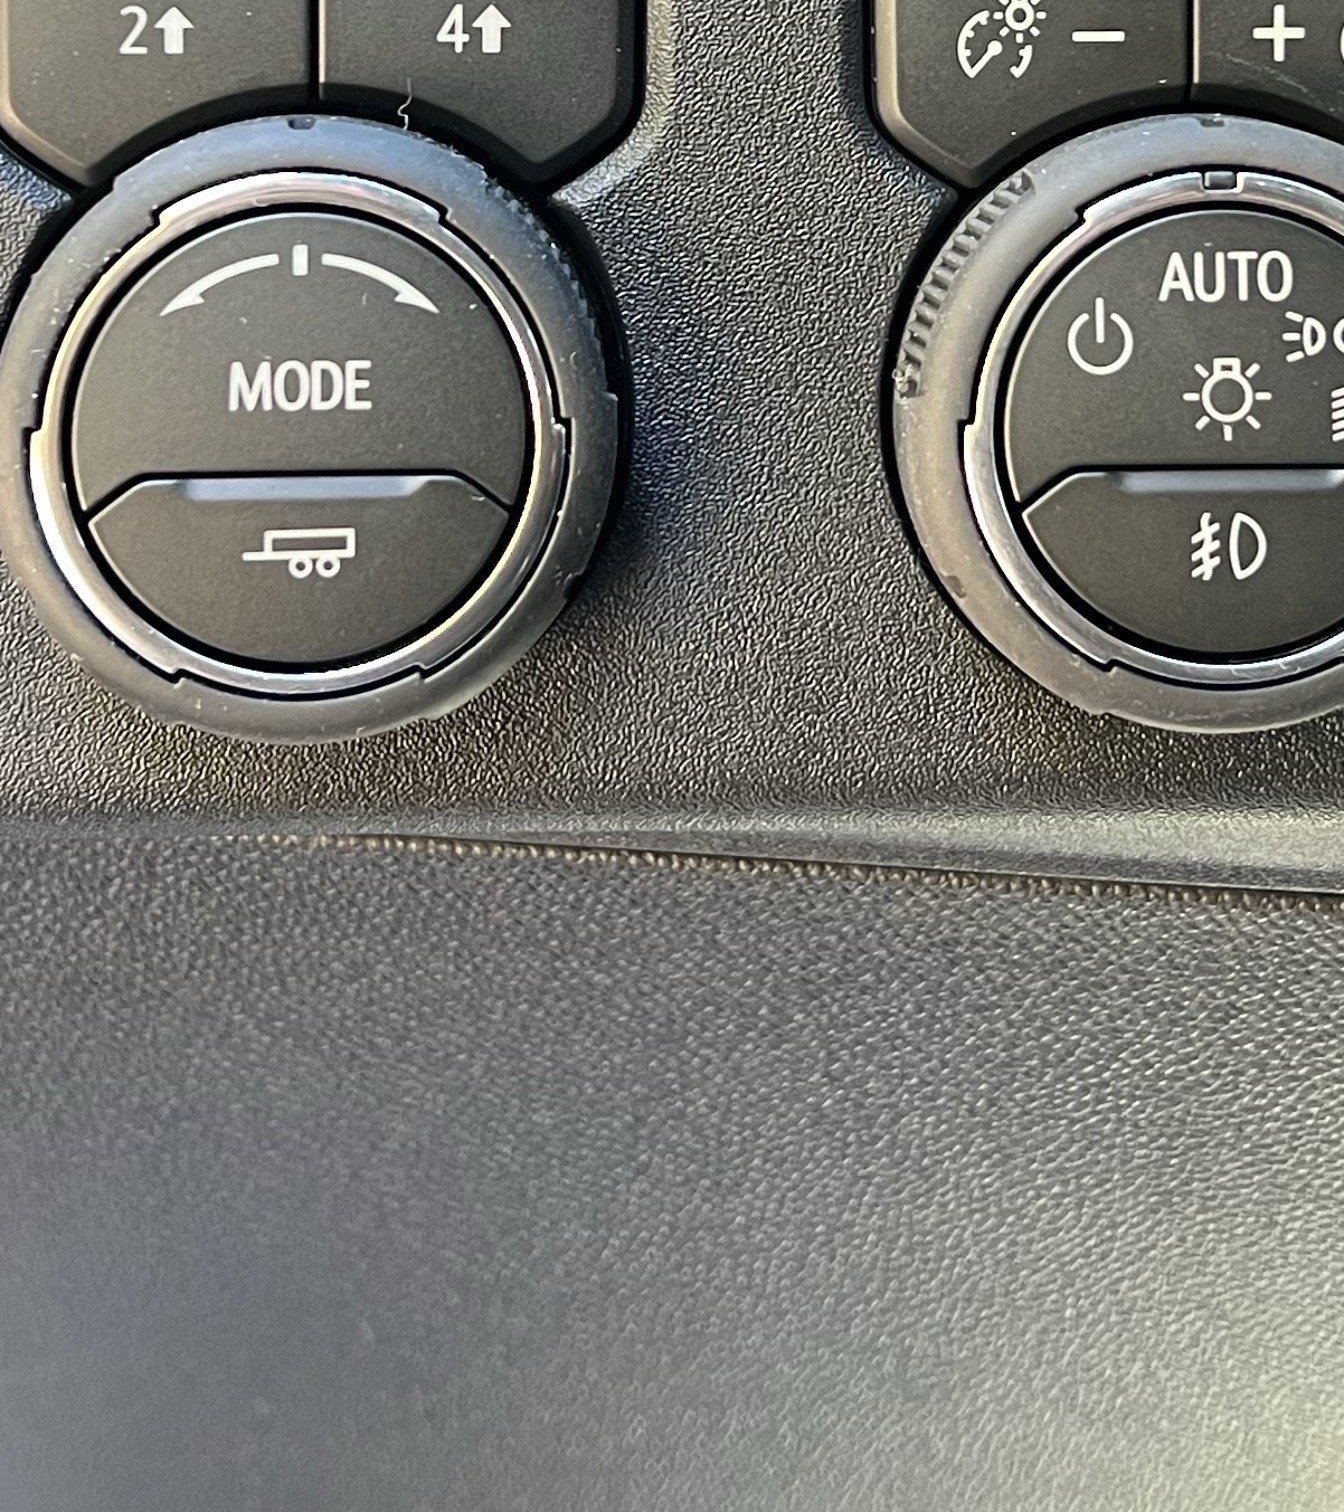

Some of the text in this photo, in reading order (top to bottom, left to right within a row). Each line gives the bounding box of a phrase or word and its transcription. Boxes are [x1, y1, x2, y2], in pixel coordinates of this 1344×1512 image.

[118, 4, 149, 55] 2
[435, 4, 470, 54] 4
[1158, 249, 1295, 304] AUTO
[227, 359, 373, 413] MODE
